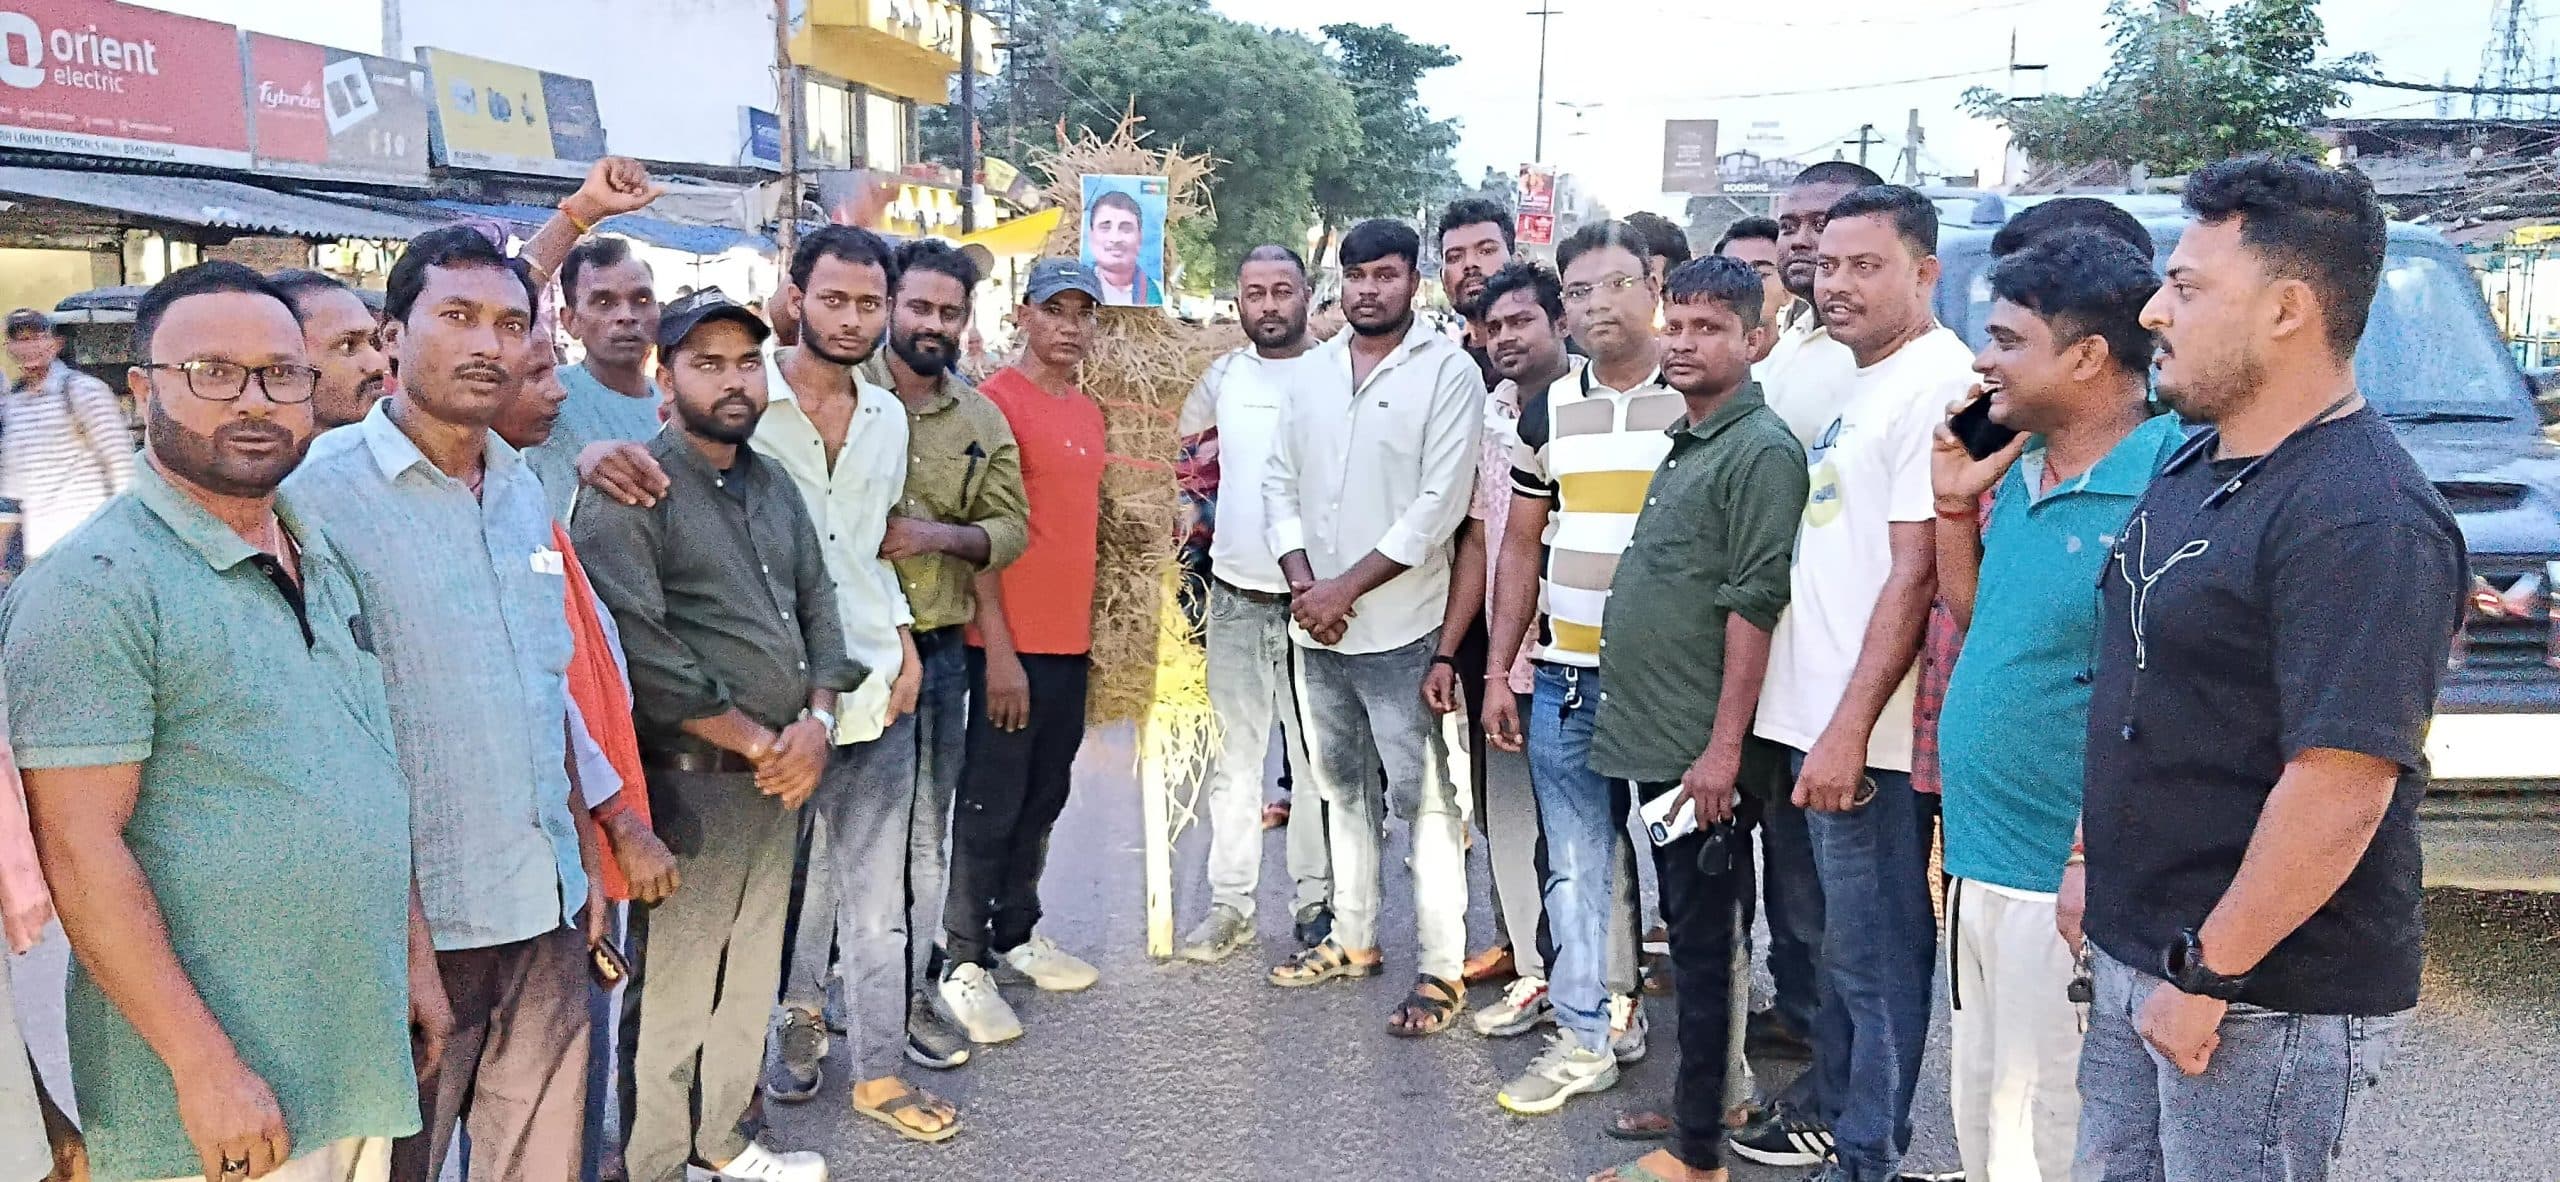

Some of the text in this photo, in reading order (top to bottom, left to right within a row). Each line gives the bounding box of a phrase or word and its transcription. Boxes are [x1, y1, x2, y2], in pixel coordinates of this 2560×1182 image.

[51, 24, 159, 76] orient
[54, 65, 125, 94] electric
[1723, 183, 1769, 193] BOOKING
